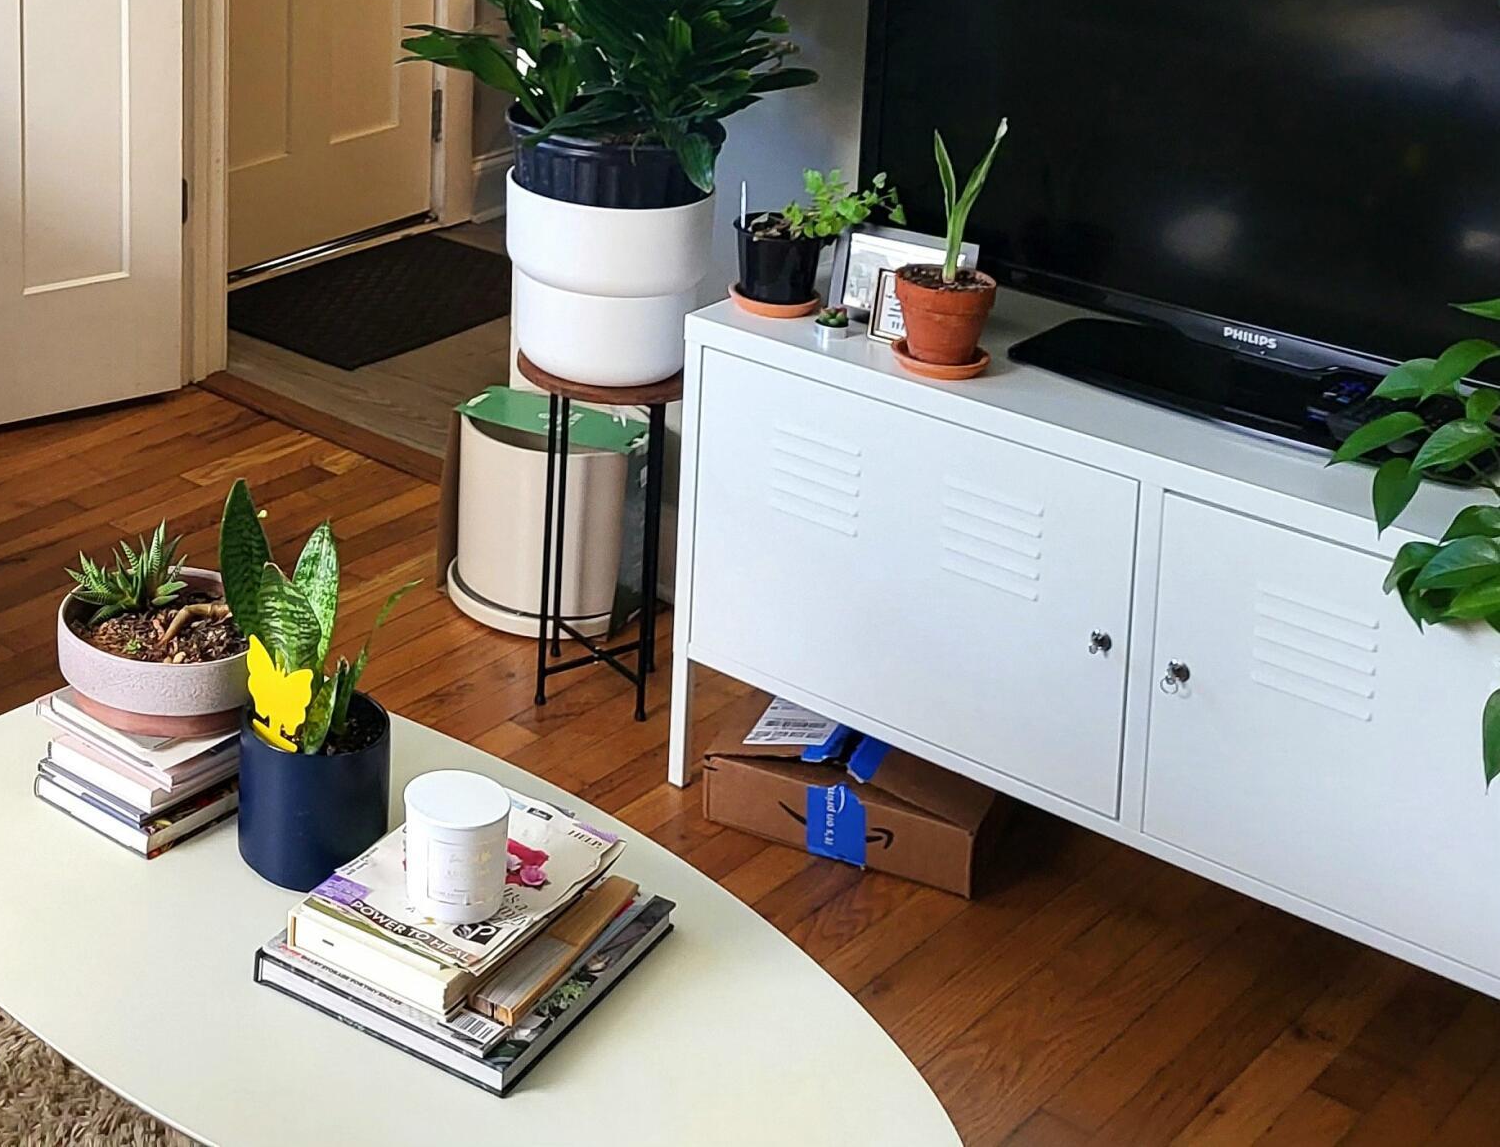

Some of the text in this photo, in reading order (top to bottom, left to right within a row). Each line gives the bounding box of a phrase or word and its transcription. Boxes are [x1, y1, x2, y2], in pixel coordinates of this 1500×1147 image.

[1223, 326, 1277, 349] PHILIPS
[824, 786, 837, 845] It's on prim
[351, 900, 470, 962] POWER TO HEAL
[322, 964, 350, 981] STORAGE
[350, 978, 364, 987] FOR
[363, 984, 378, 994] TINY
[378, 992, 403, 1006] SPACES
